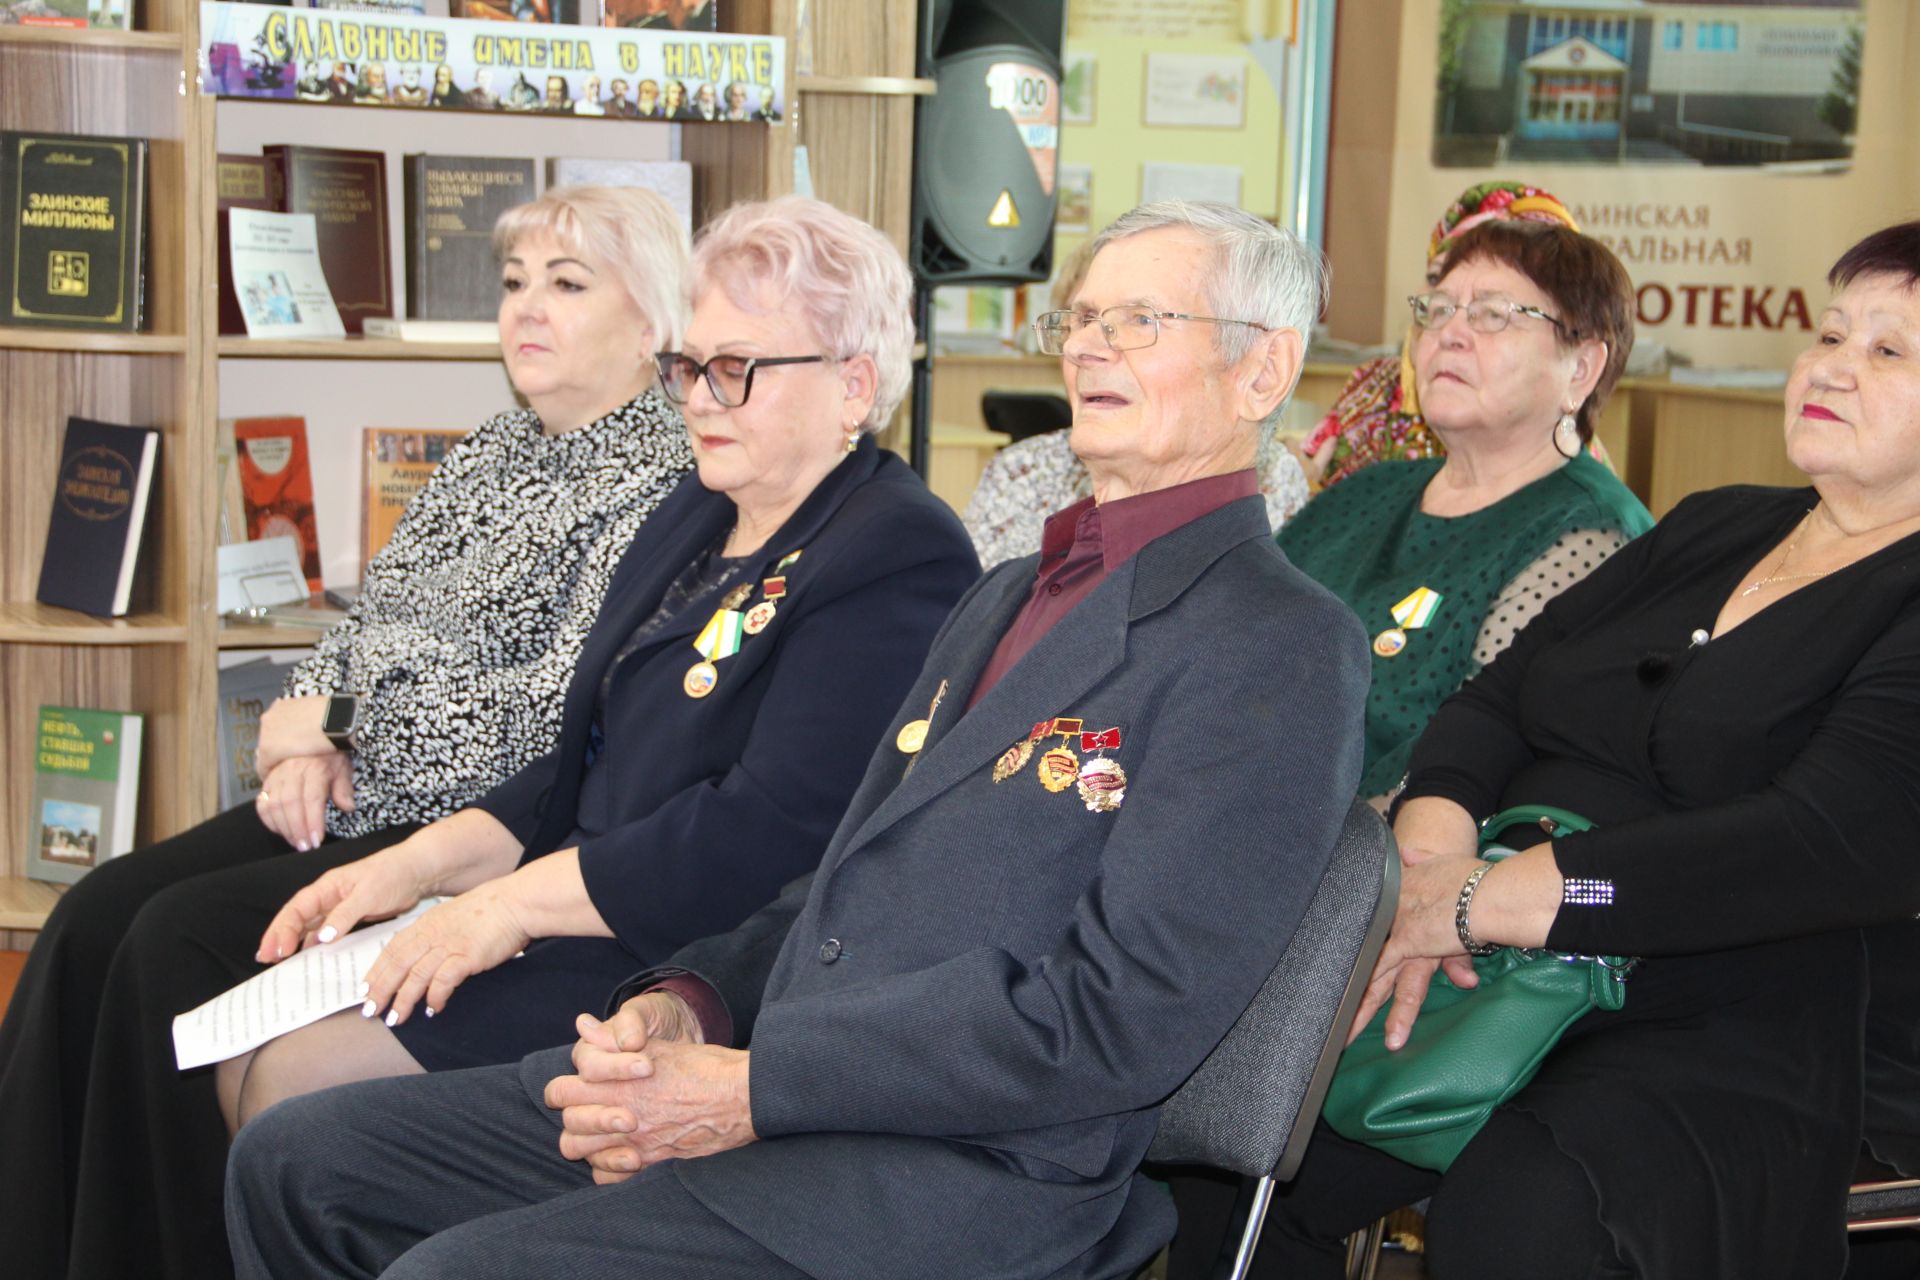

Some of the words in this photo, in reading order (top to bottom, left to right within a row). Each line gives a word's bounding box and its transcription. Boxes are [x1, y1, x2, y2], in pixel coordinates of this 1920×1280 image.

[266, 12, 446, 63] СЛАВНЫЕ
[474, 35, 594, 70] ИМЕНА
[618, 42, 639, 73] В
[664, 42, 772, 85] НАУКЕ
[29, 193, 110, 214] ЗАИНСКИЕ
[22, 208, 115, 231] МИЛЛИОНЫ
[1573, 204, 1710, 228] АИНСКАЯ
[1604, 234, 1753, 265] АЛЬНАЯ
[1635, 281, 1814, 331] ОТЕКА
[390, 468, 433, 480] Лаур
